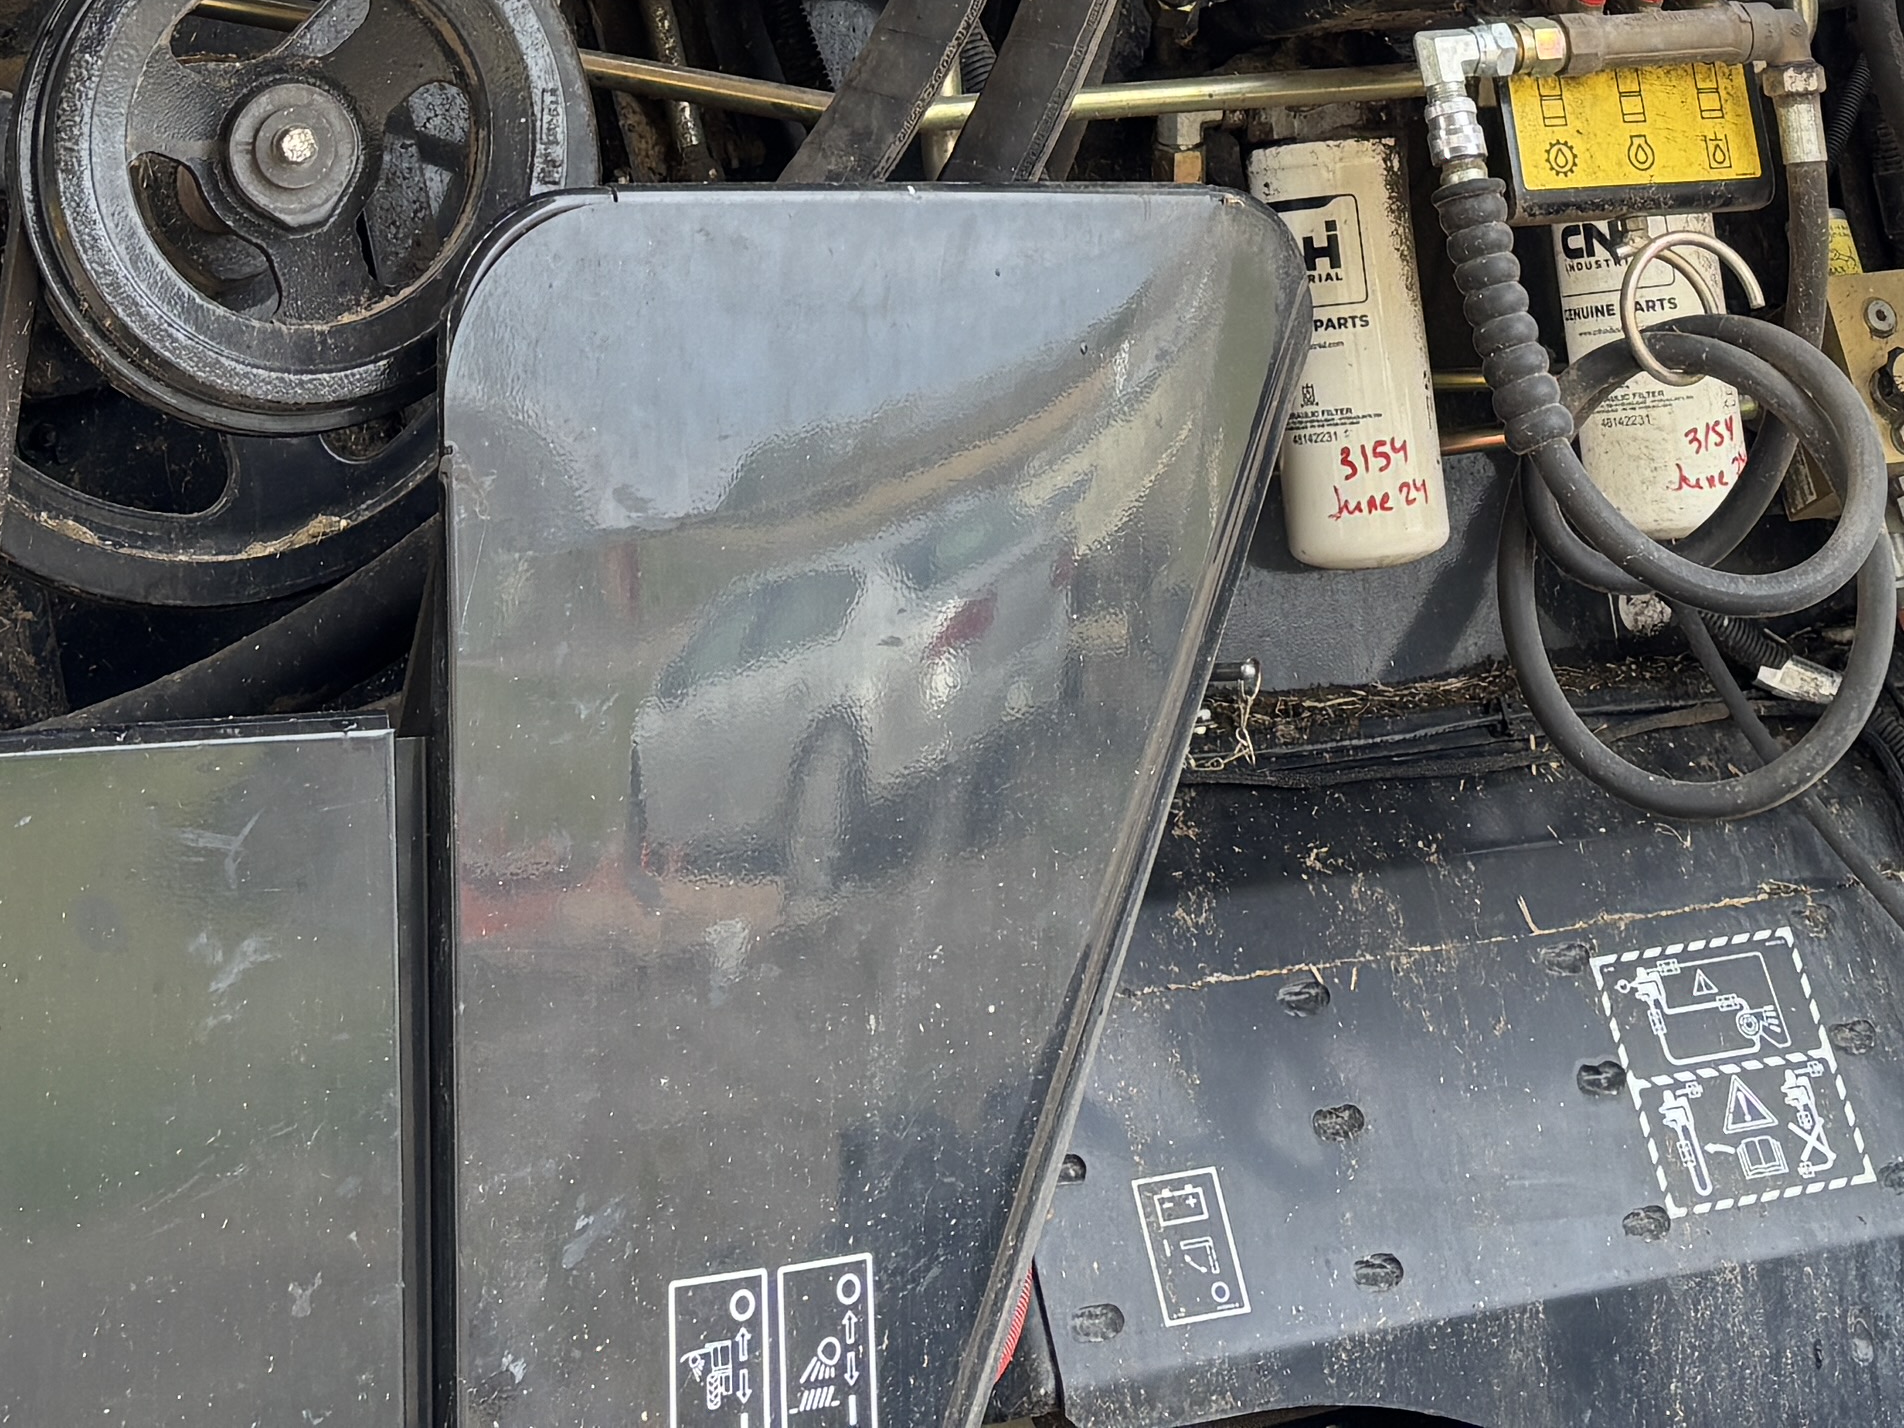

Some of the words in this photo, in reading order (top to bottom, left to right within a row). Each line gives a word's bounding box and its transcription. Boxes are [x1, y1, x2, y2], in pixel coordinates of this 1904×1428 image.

[1564, 304, 1616, 321] GENUINE
[1634, 297, 1678, 313] ARTS
[1313, 314, 1370, 332] PARTS
[1631, 390, 1665, 400] FILTER
[1321, 407, 1353, 417] FILTER
[1684, 414, 1734, 455] 3154
[1340, 436, 1408, 481] 3154
[1328, 485, 1394, 521] June
[1398, 478, 1428, 506] 24
